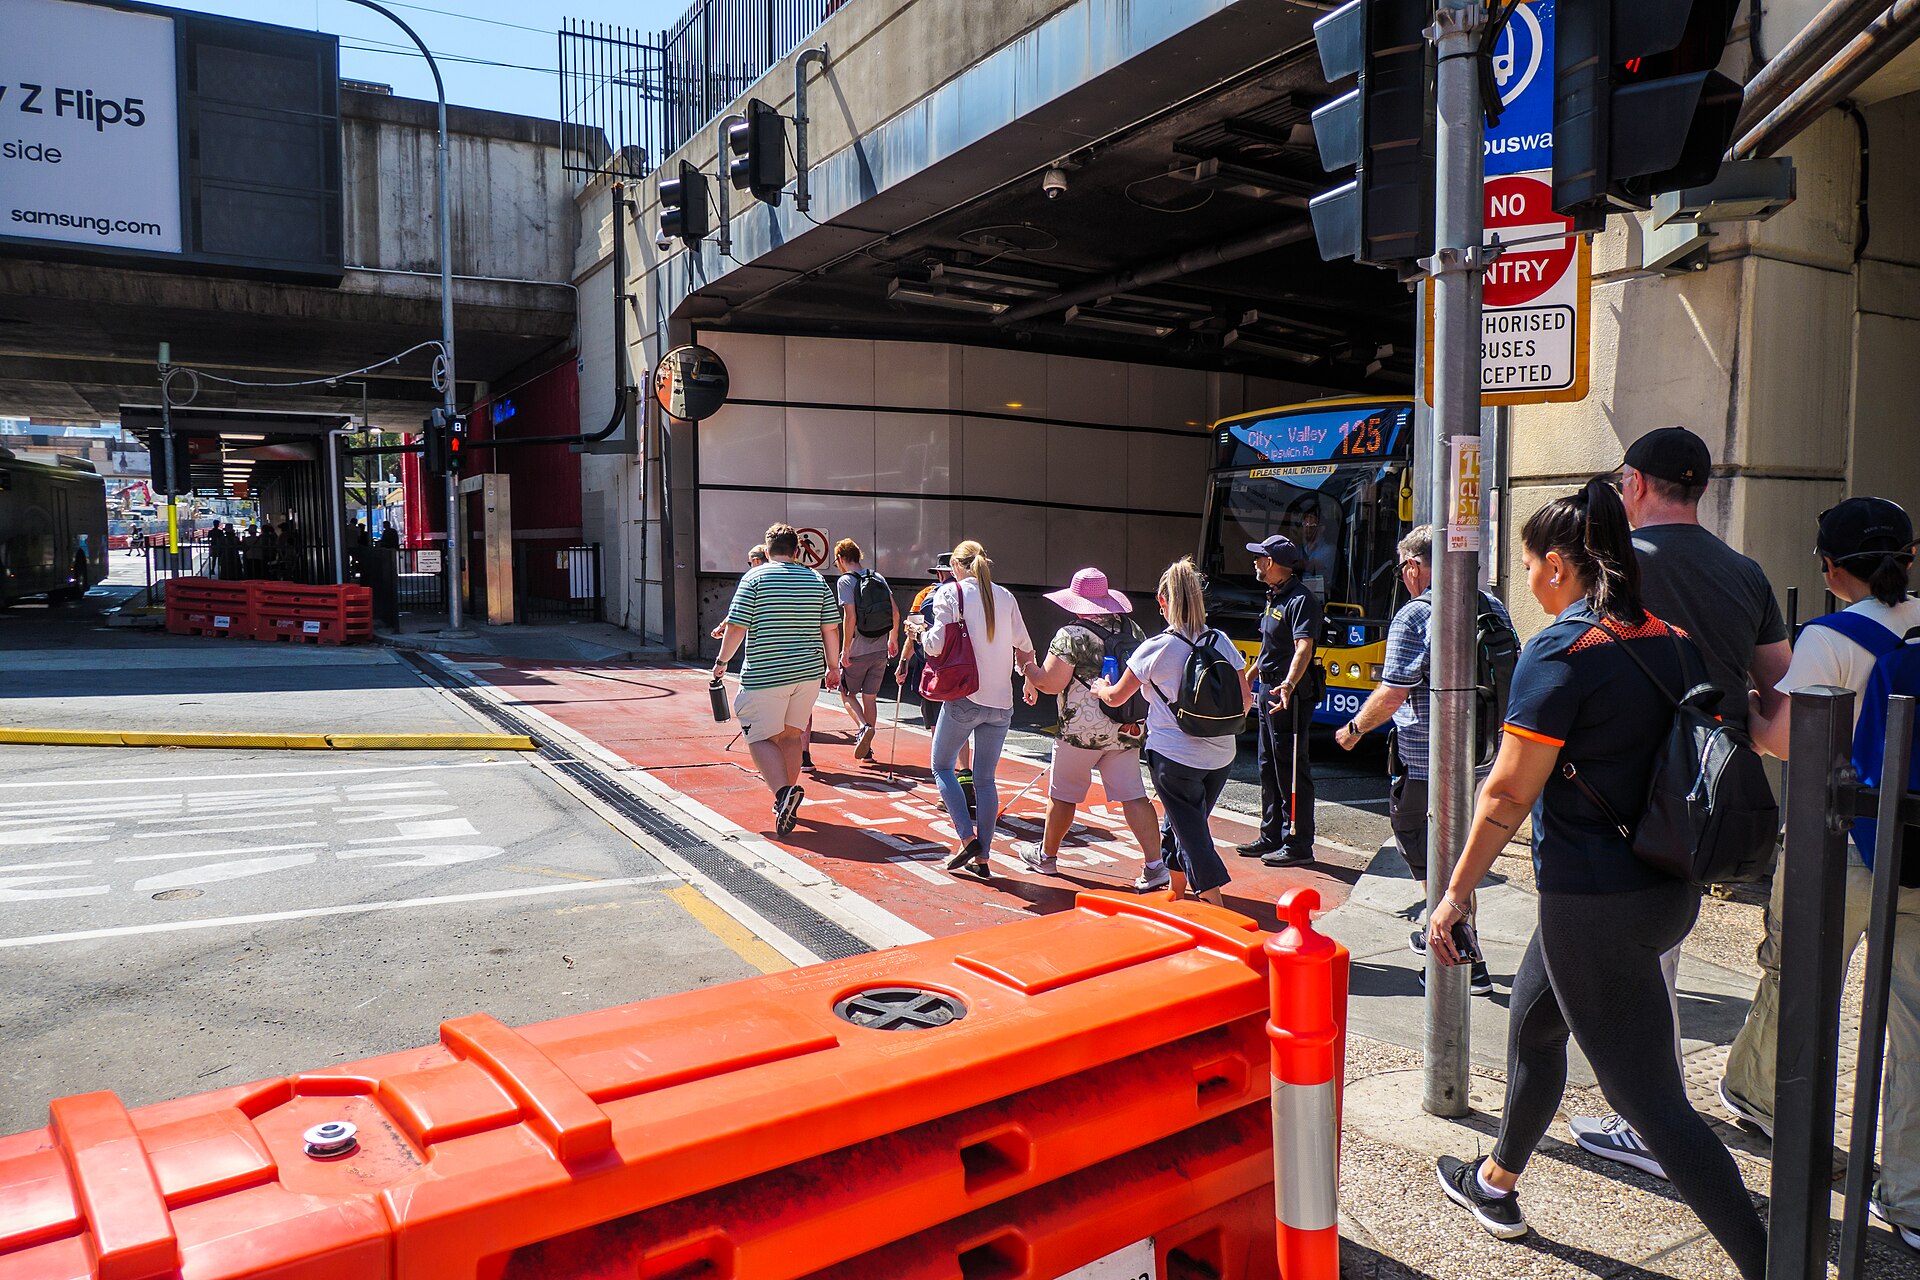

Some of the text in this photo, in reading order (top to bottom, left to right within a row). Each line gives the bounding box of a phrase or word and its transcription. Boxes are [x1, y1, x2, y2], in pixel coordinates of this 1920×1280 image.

[20, 82, 43, 114] Z
[55, 87, 146, 132] Flip5
[3, 139, 62, 164] side
[1490, 193, 1526, 218] NO
[11, 209, 161, 236] samsung.com
[1482, 258, 1550, 285] NTRY
[1481, 312, 1565, 334] HORISED
[1481, 365, 1552, 384] CEPTED
[1248, 431, 1273, 448] City
[1287, 425, 1327, 444] Valley
[1338, 418, 1380, 455] 125
[1283, 467, 1298, 475] HAIL
[1315, 693, 1362, 713] 199
